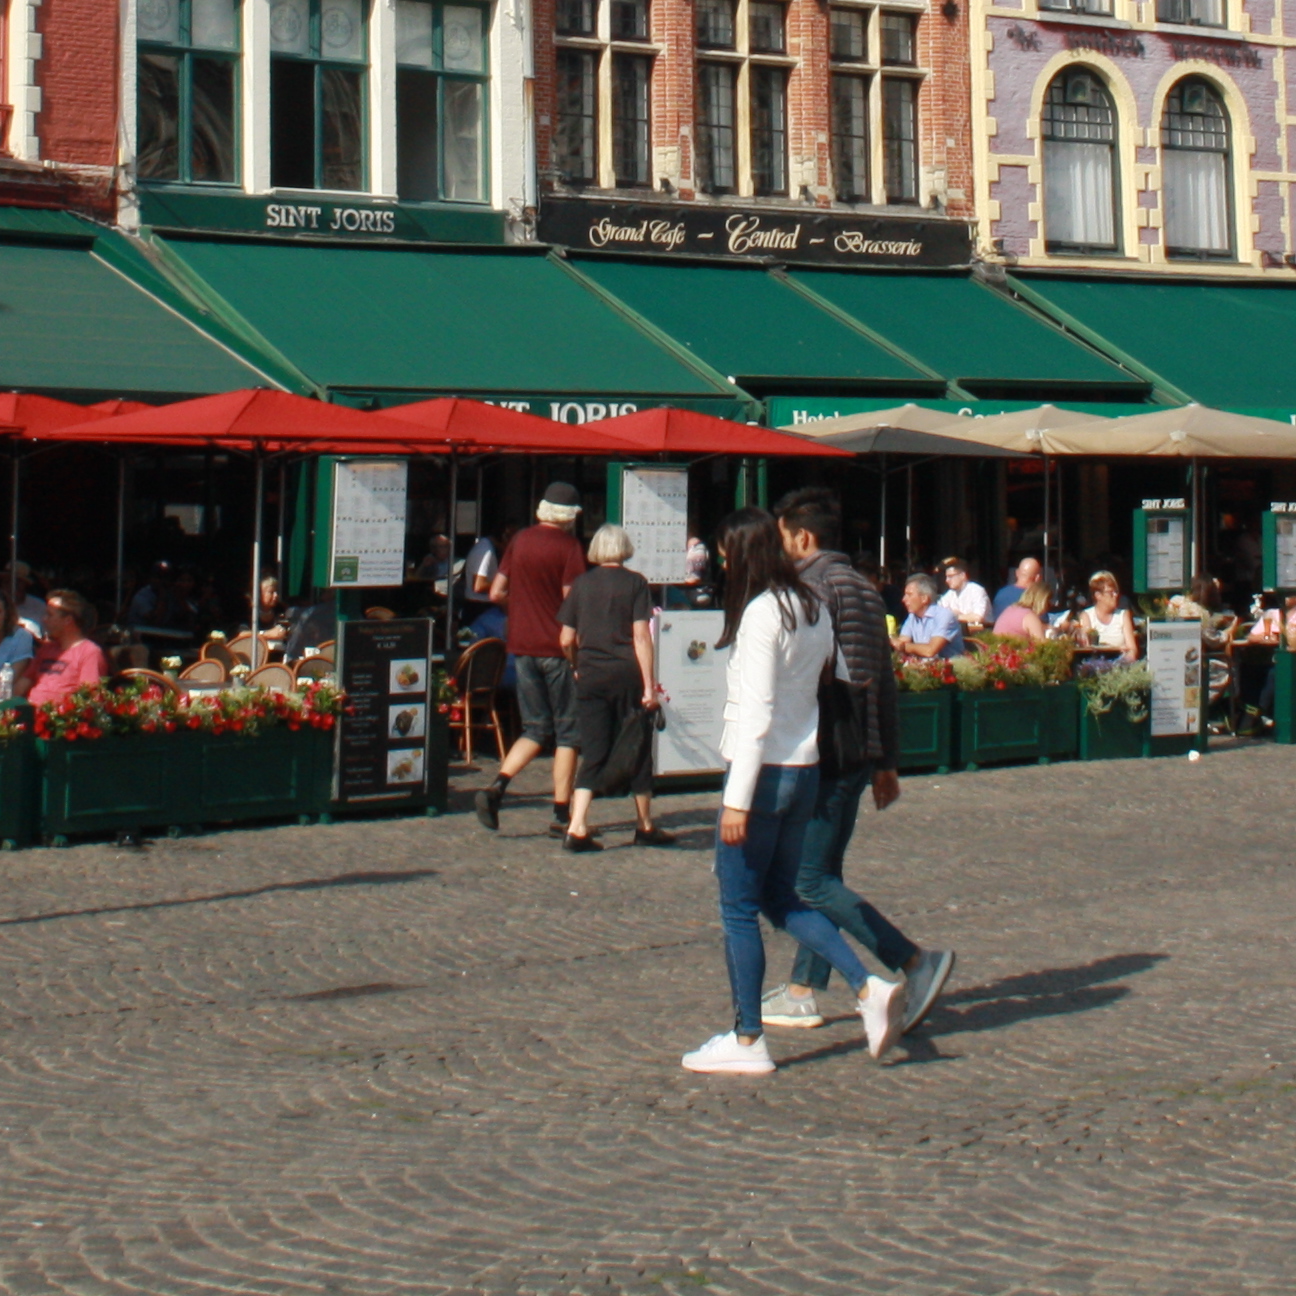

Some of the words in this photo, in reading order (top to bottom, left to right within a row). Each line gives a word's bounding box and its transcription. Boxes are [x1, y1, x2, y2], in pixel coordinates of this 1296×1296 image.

[266, 204, 321, 229] SINT
[330, 207, 395, 233] JORIS
[588, 217, 648, 247] Grand
[724, 213, 802, 254] Central
[833, 230, 923, 255] Brasserie
